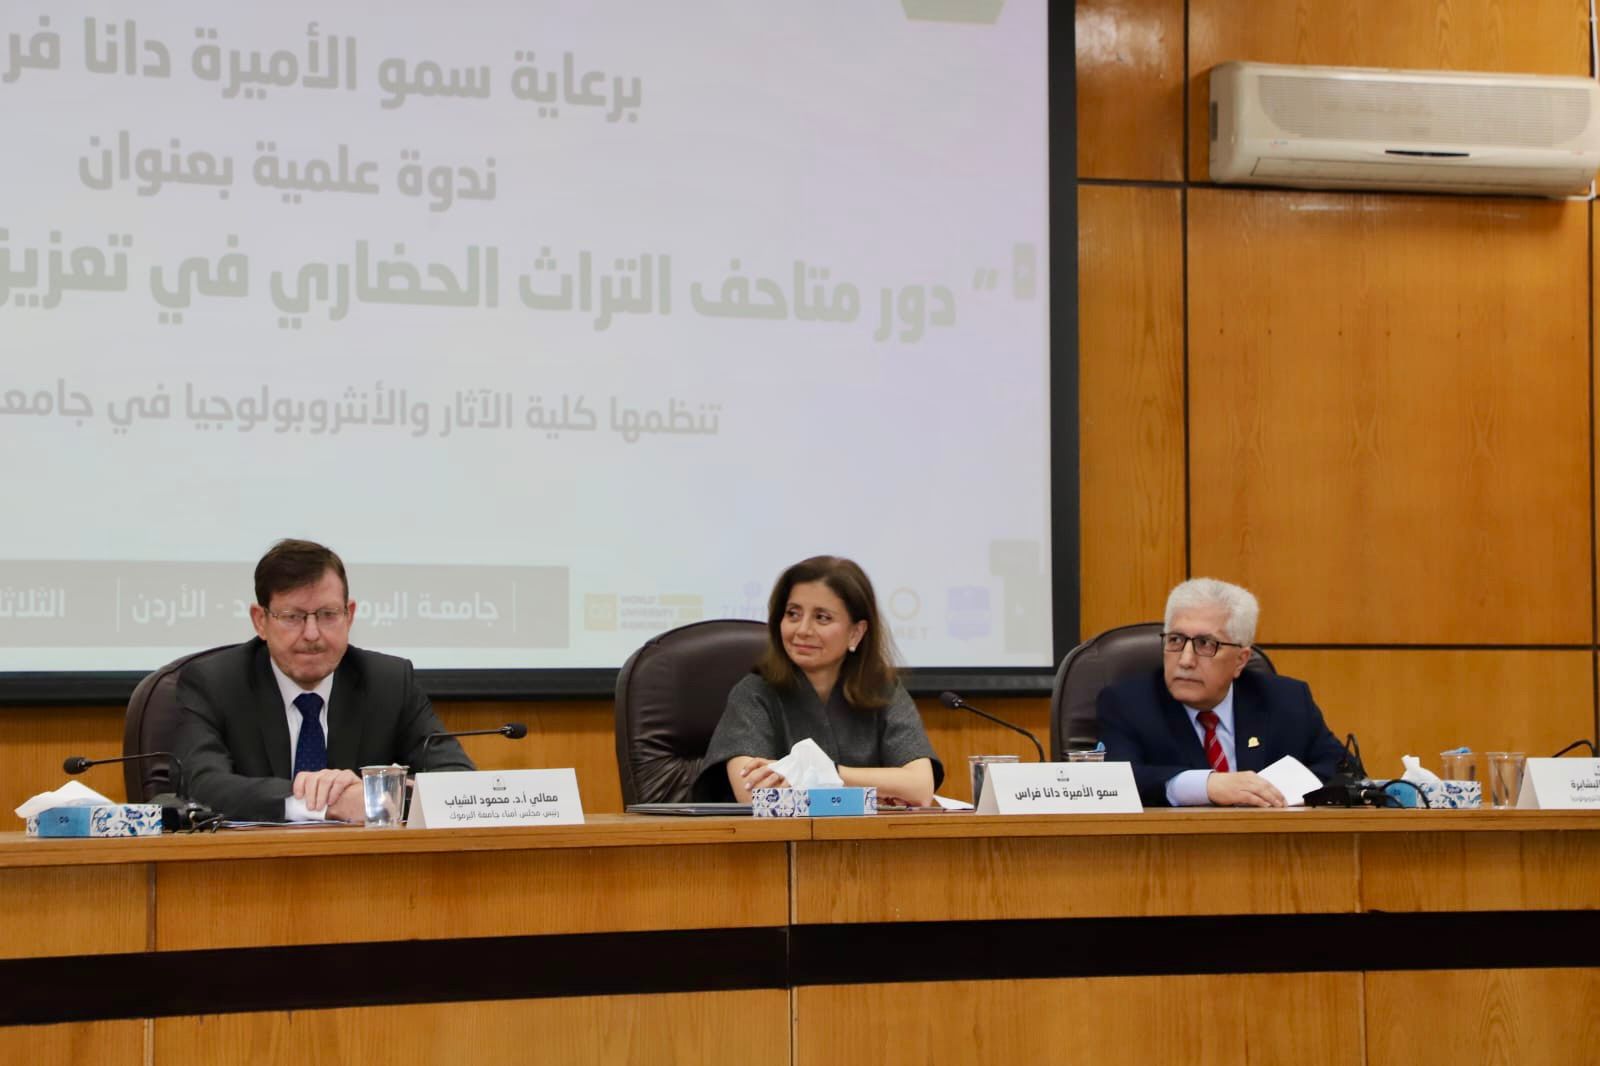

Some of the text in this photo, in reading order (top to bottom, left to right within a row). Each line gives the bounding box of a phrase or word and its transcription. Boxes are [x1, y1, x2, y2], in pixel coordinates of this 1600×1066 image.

[84, 16, 171, 78] دانا
[192, 21, 357, 100] الأميرة
[378, 58, 490, 110] سمو
[511, 50, 642, 123] برعاية
[78, 130, 496, 213] ندوة علمية بعنوان
[150, 234, 249, 325] في
[270, 240, 499, 330] الحضاري
[518, 246, 672, 331] التراث
[690, 258, 860, 323] متاحف
[0, 378, 722, 443] تنظمها كلية الآثار والأنثروبولوجيا في جامع
[132, 585, 205, 626] الأردن
[418, 592, 498, 626] جامعة
[480, 796, 510, 807] محمود
[530, 793, 559, 807] معالي
[1015, 784, 1118, 800] سمو الأميرة دانا فراس
